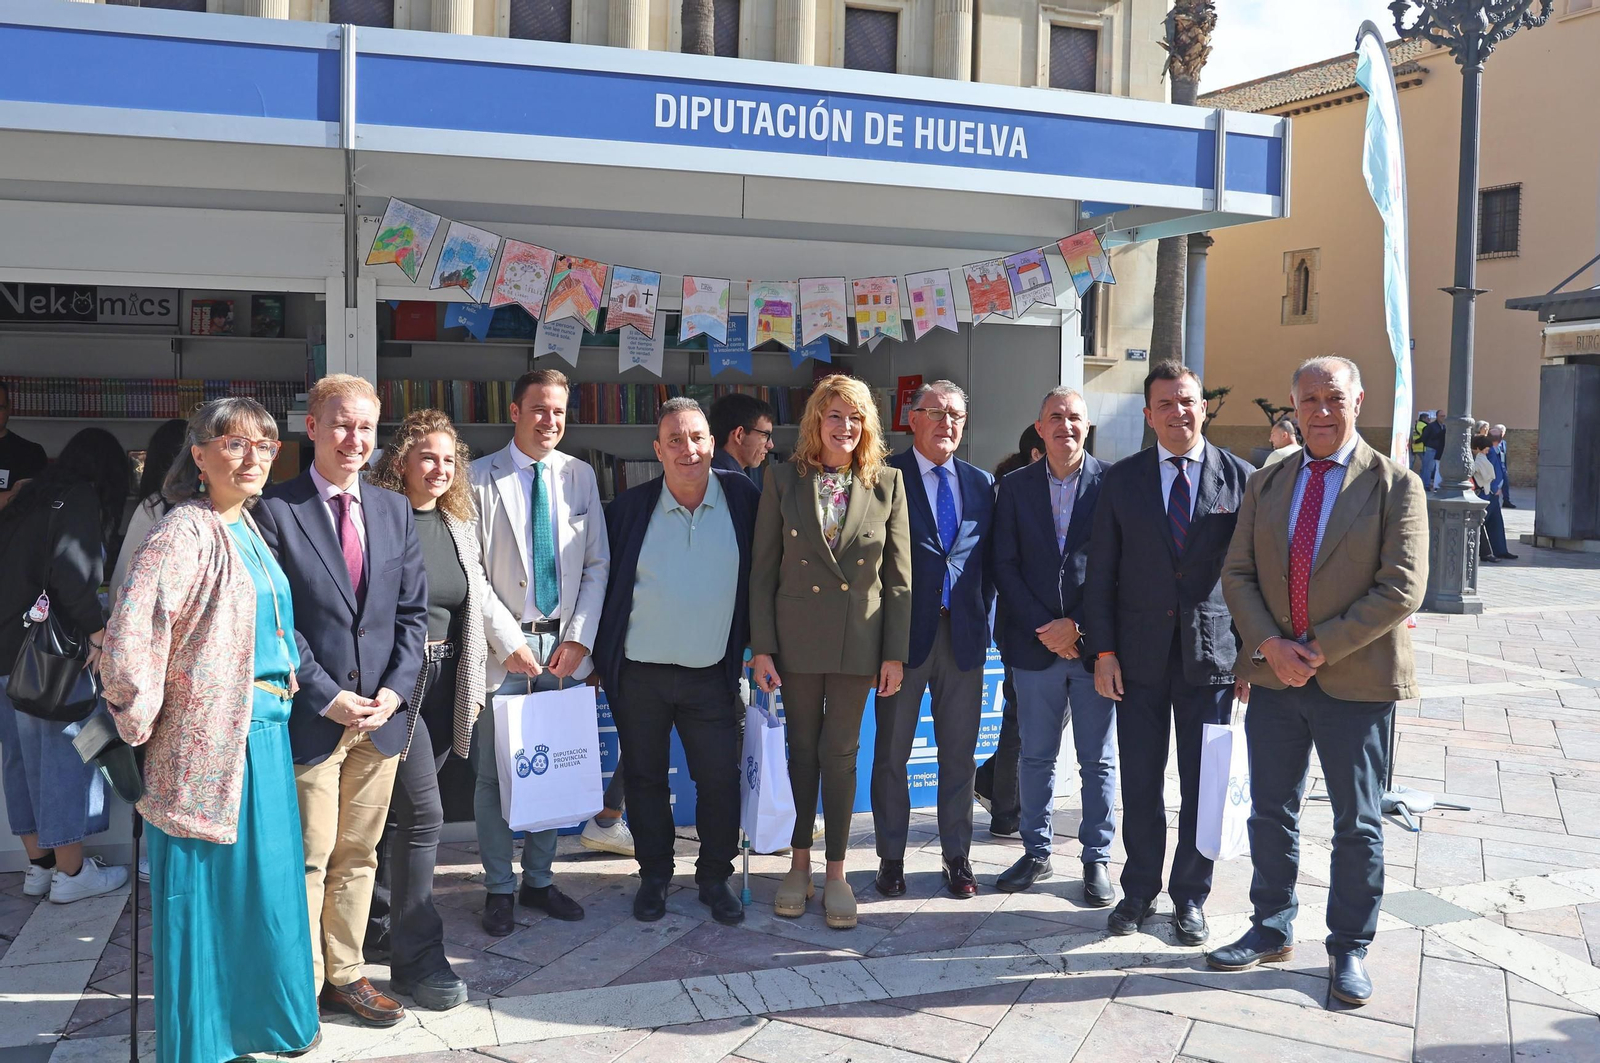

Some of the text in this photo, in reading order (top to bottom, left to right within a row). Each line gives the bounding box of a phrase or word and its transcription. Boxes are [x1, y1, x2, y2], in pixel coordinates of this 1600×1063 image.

[655, 93, 1029, 159] DIPUTACIÓN DE HUELVA
[555, 322, 575, 330] persona
[560, 328, 576, 336] nunca
[553, 748, 588, 758] DIPUTACIÓN
[554, 754, 588, 763] PROVINCIAL
[560, 760, 581, 768] HUELVA
